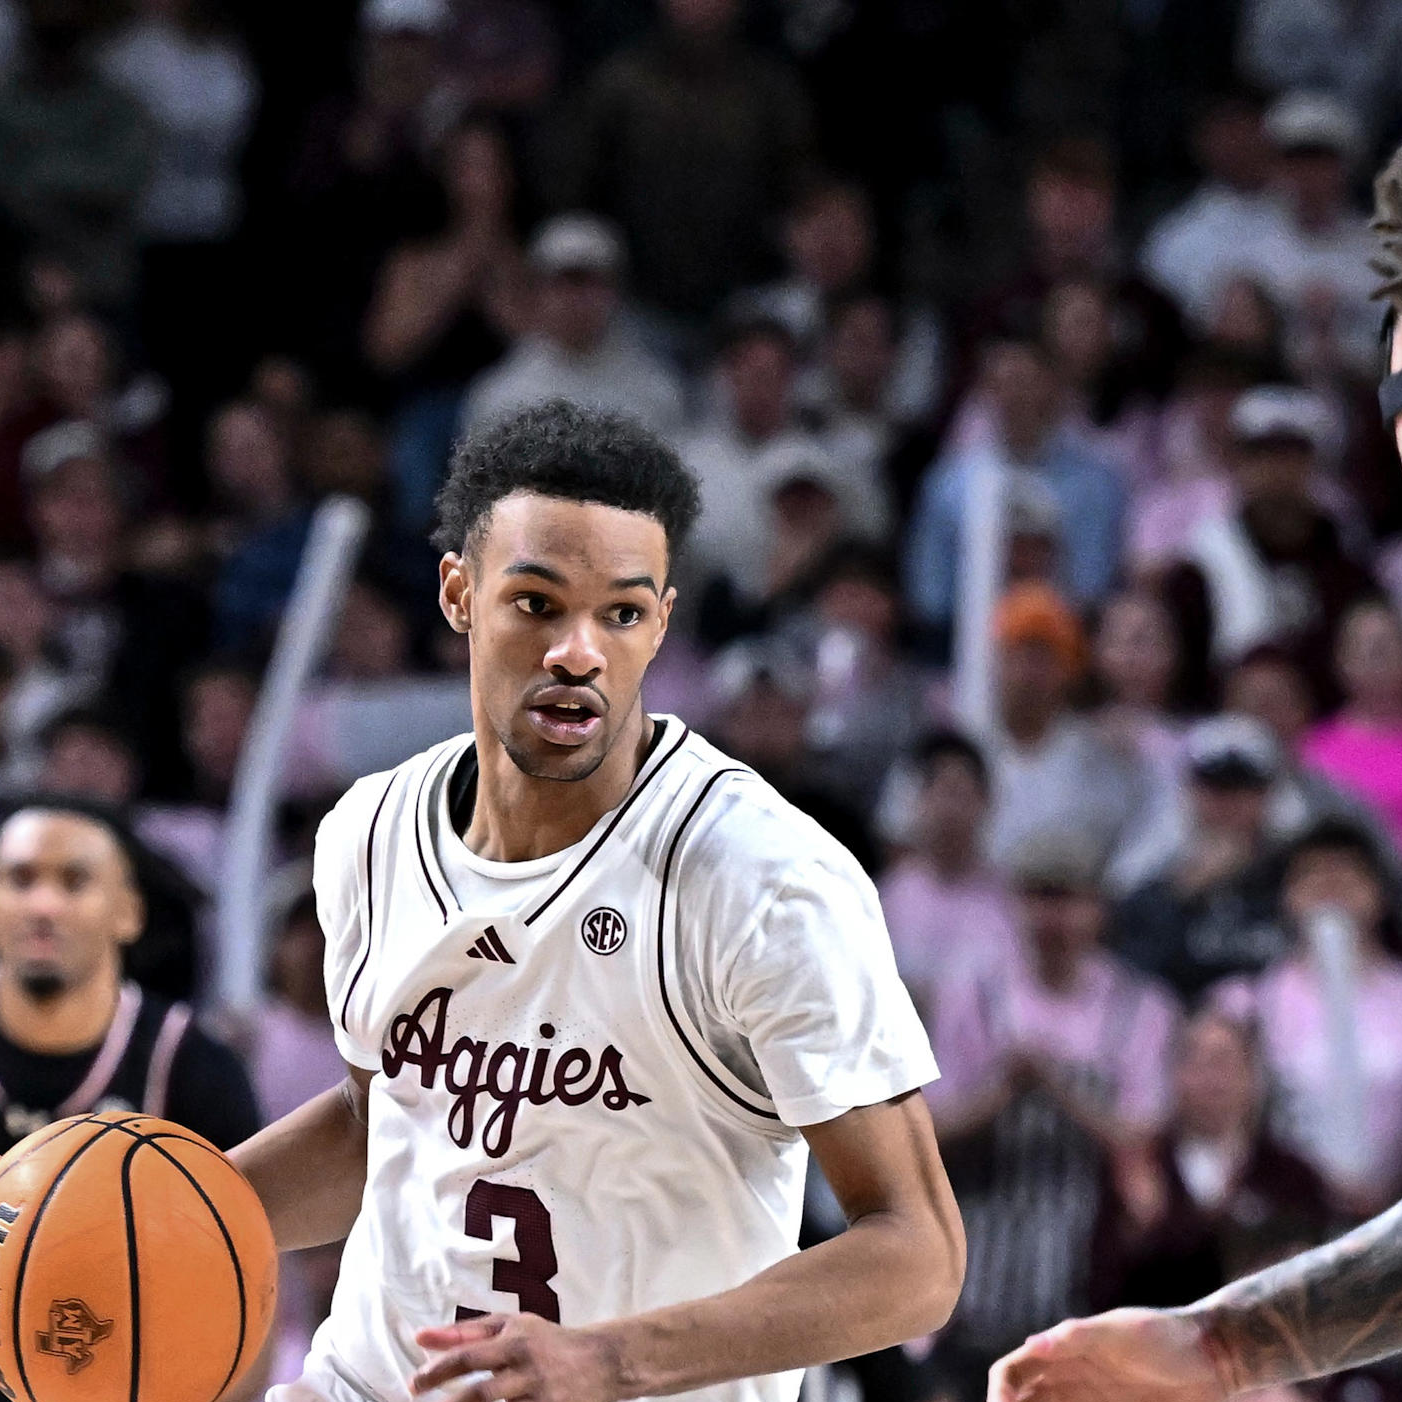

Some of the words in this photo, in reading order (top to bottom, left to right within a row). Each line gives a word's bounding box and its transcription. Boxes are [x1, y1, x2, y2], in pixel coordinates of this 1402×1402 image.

[587, 911, 622, 950] SEC
[382, 986, 652, 1159] Aggies
[455, 1178, 561, 1325] 3
